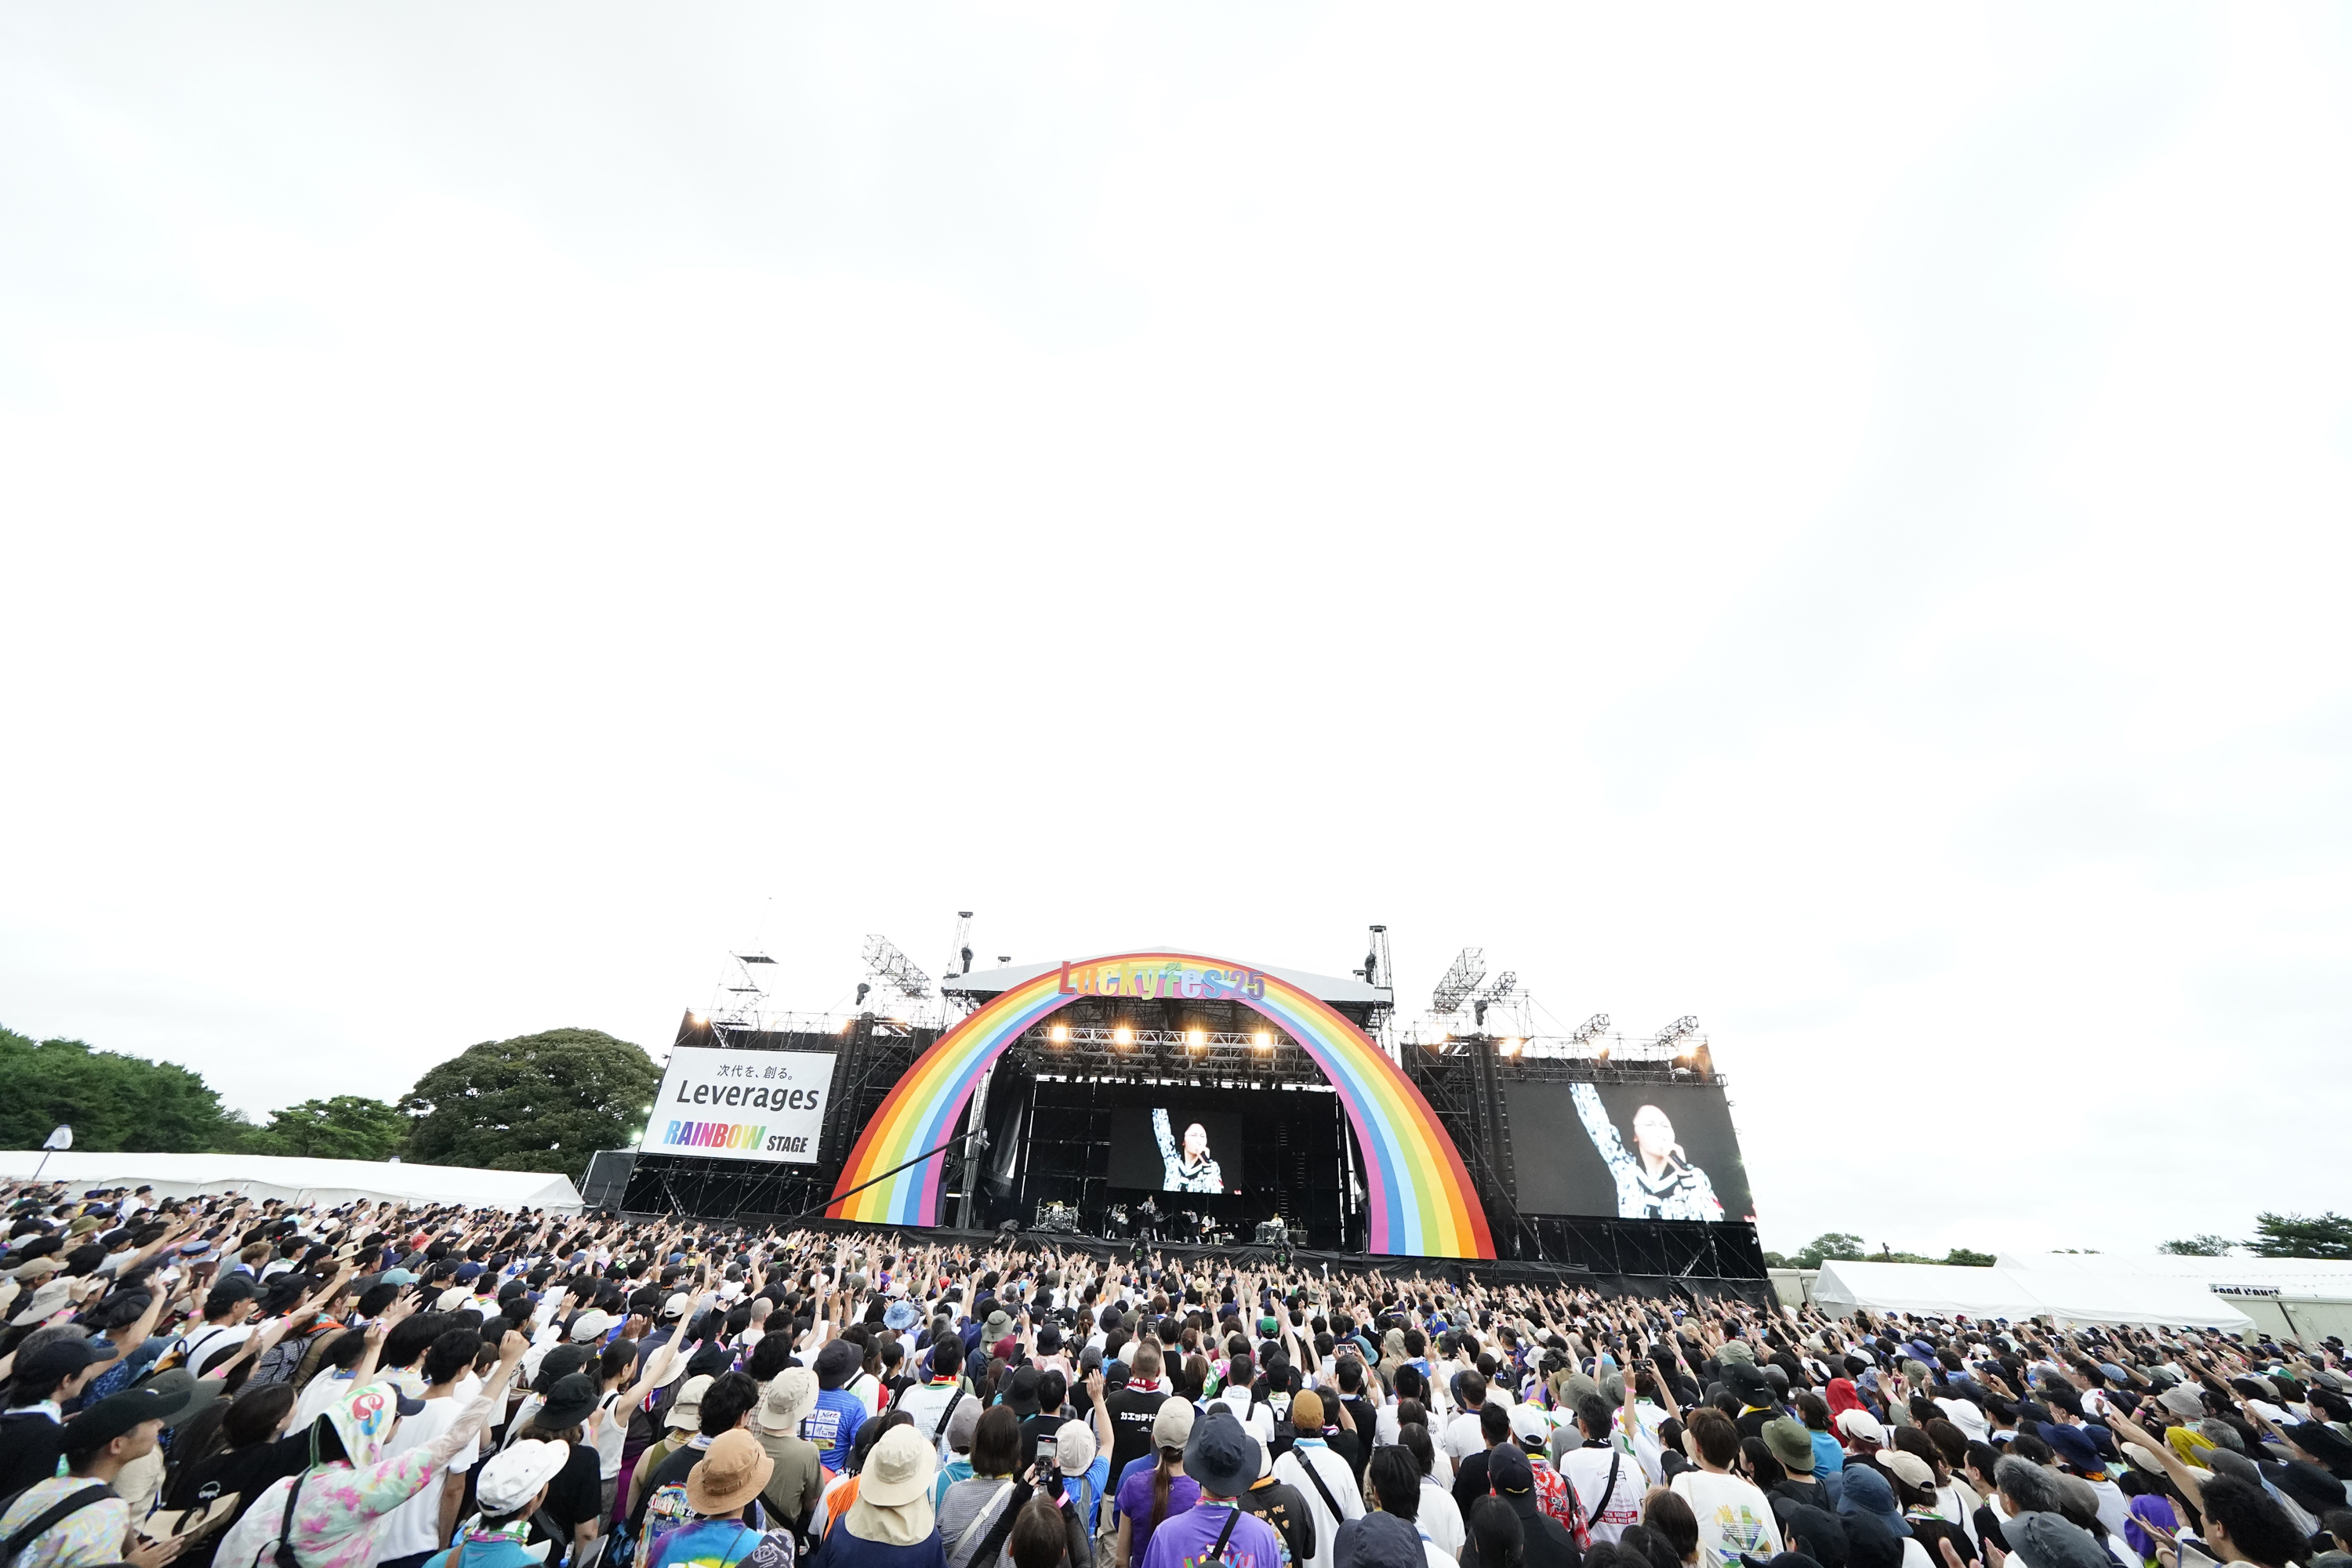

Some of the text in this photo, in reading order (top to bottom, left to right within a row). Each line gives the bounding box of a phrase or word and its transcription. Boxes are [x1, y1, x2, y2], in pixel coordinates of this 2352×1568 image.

[717, 1064, 793, 1080] 次代を、創る。
[677, 1080, 819, 1111] Leverages
[663, 1120, 808, 1153] RAINBOW STAGE
